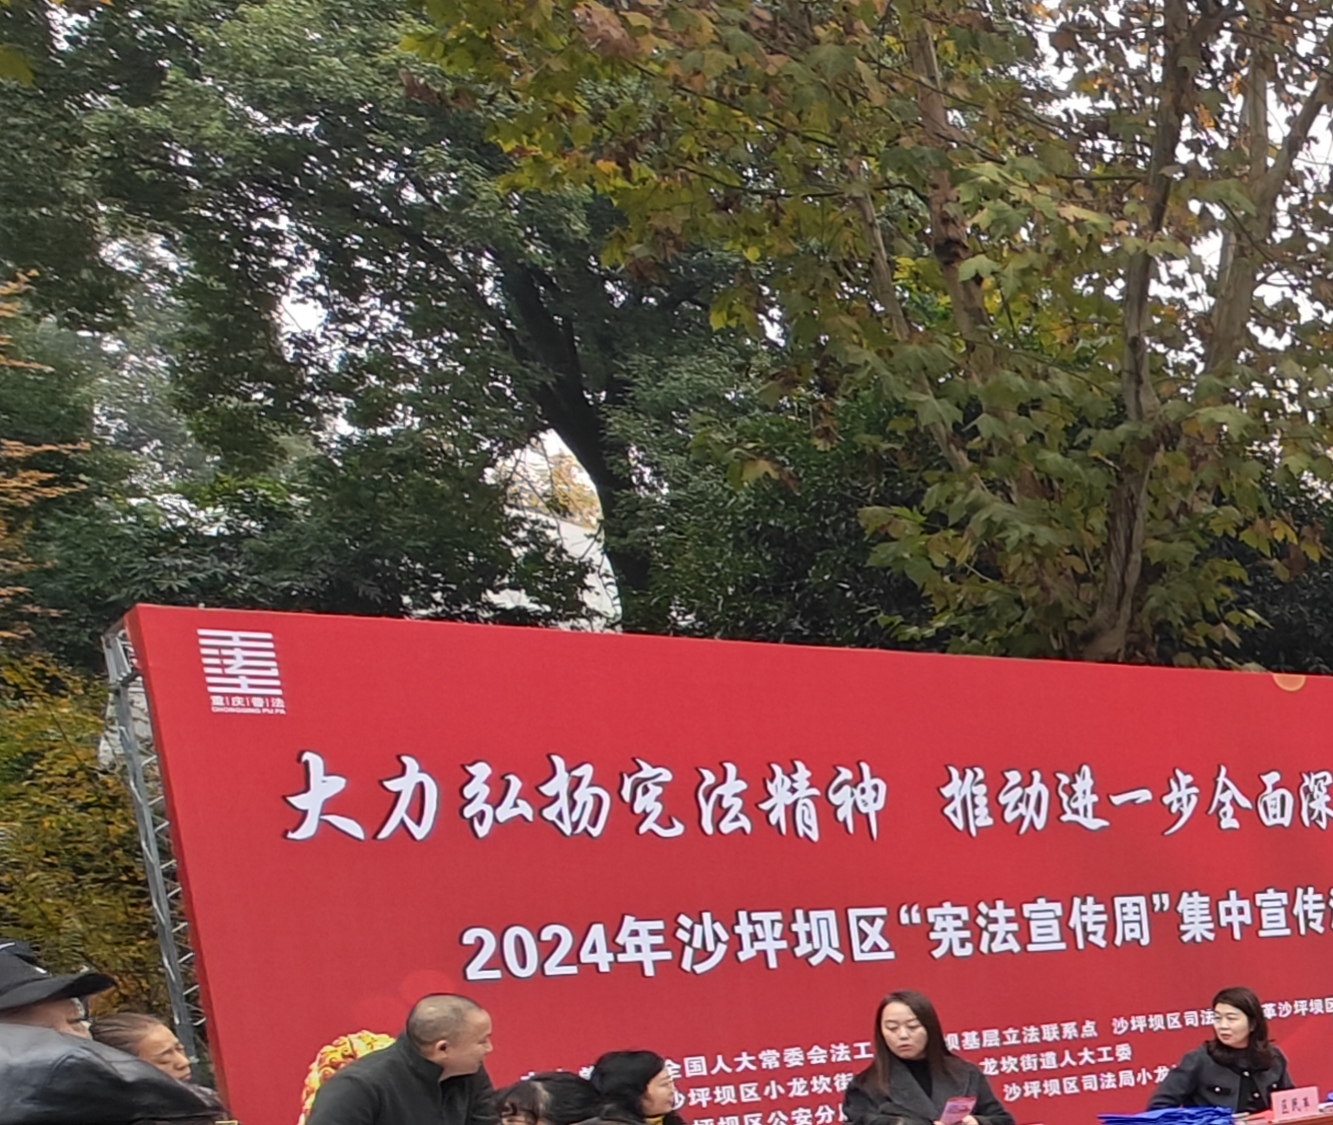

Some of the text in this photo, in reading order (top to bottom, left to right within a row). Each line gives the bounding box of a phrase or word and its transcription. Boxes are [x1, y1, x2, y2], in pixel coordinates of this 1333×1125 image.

[286, 751, 888, 842] 大力弘扬宪法精神
